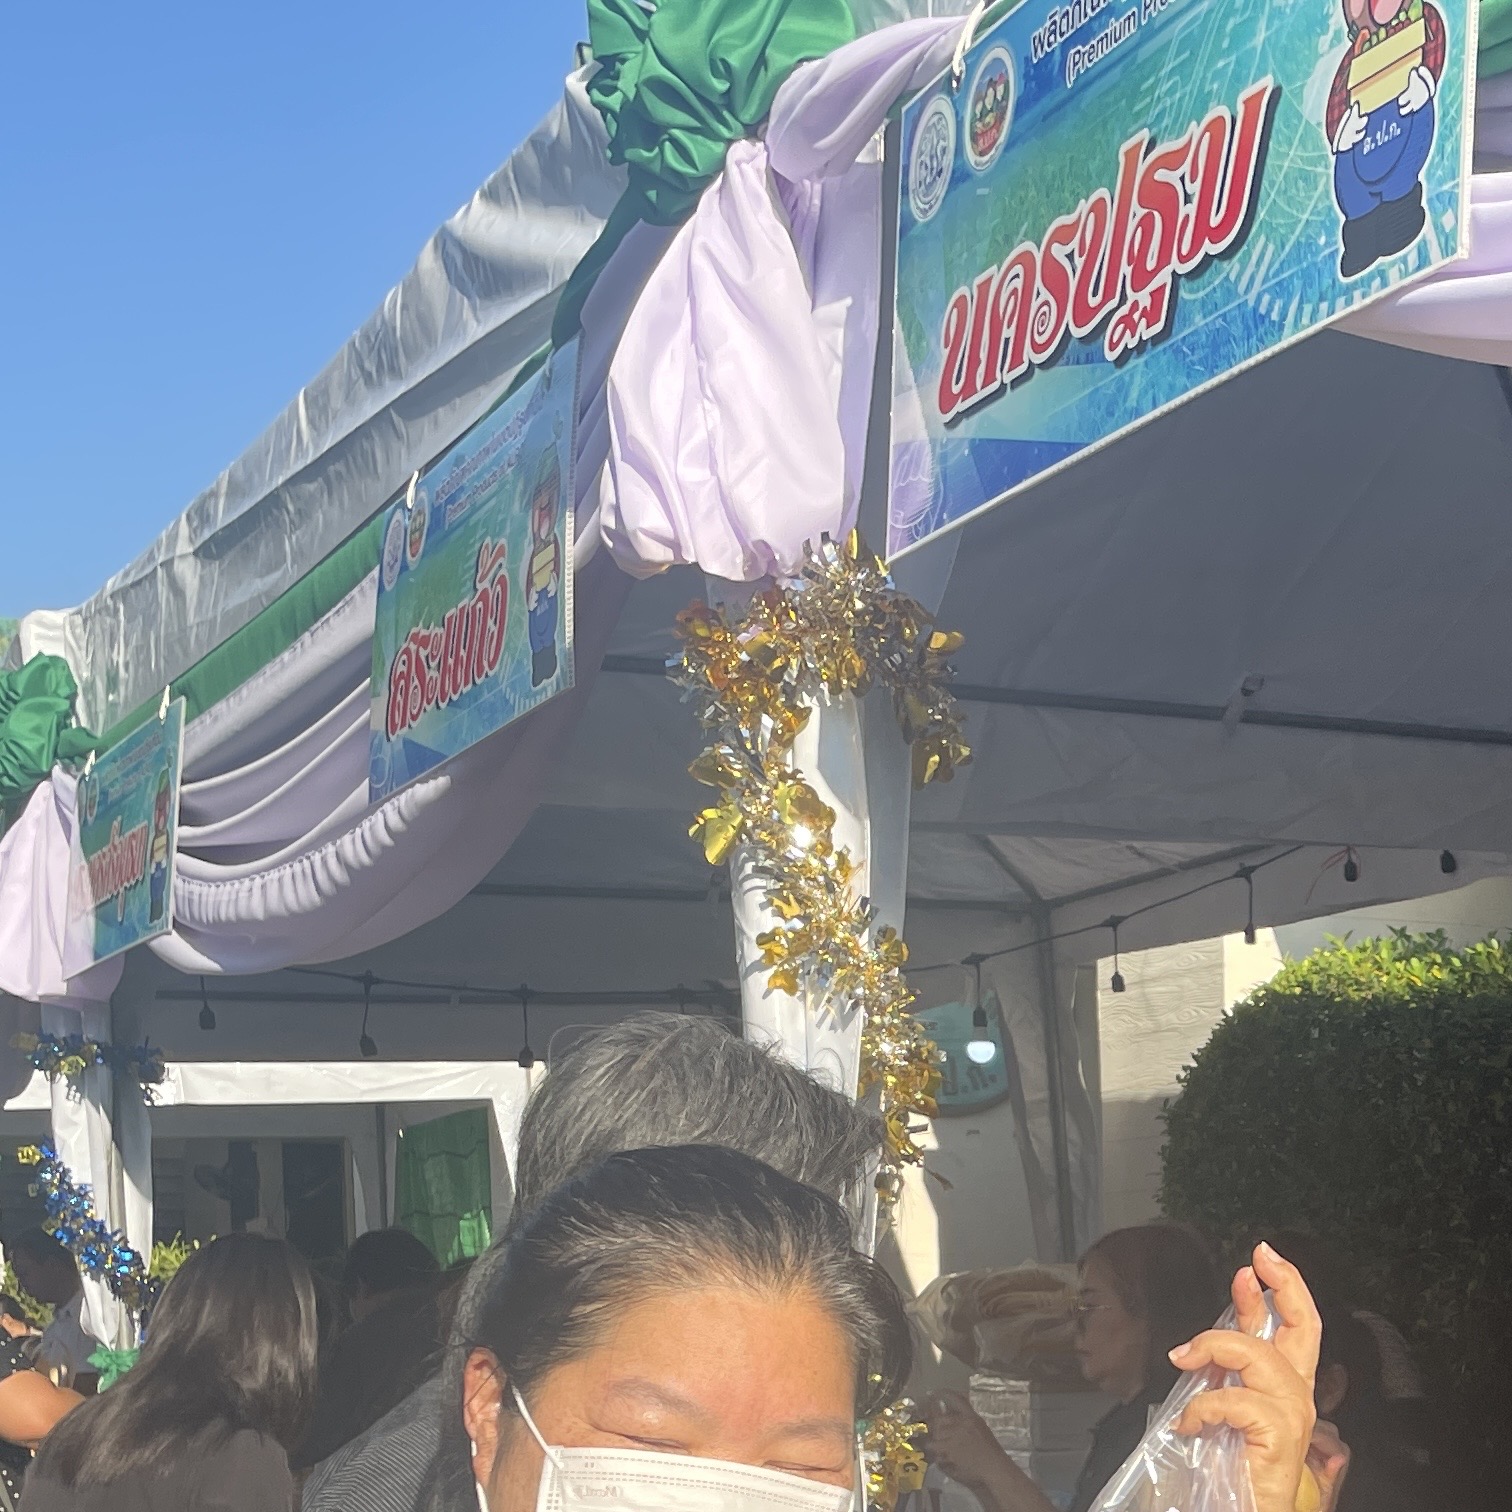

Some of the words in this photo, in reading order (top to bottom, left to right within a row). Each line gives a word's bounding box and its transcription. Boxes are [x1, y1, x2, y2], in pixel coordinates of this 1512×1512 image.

[1067, 9, 1137, 86] (Premium
[1363, 120, 1400, 155] ส.ป.ก.
[938, 80, 1273, 424] นครปฐม
[388, 537, 509, 739] สระแก้ว
